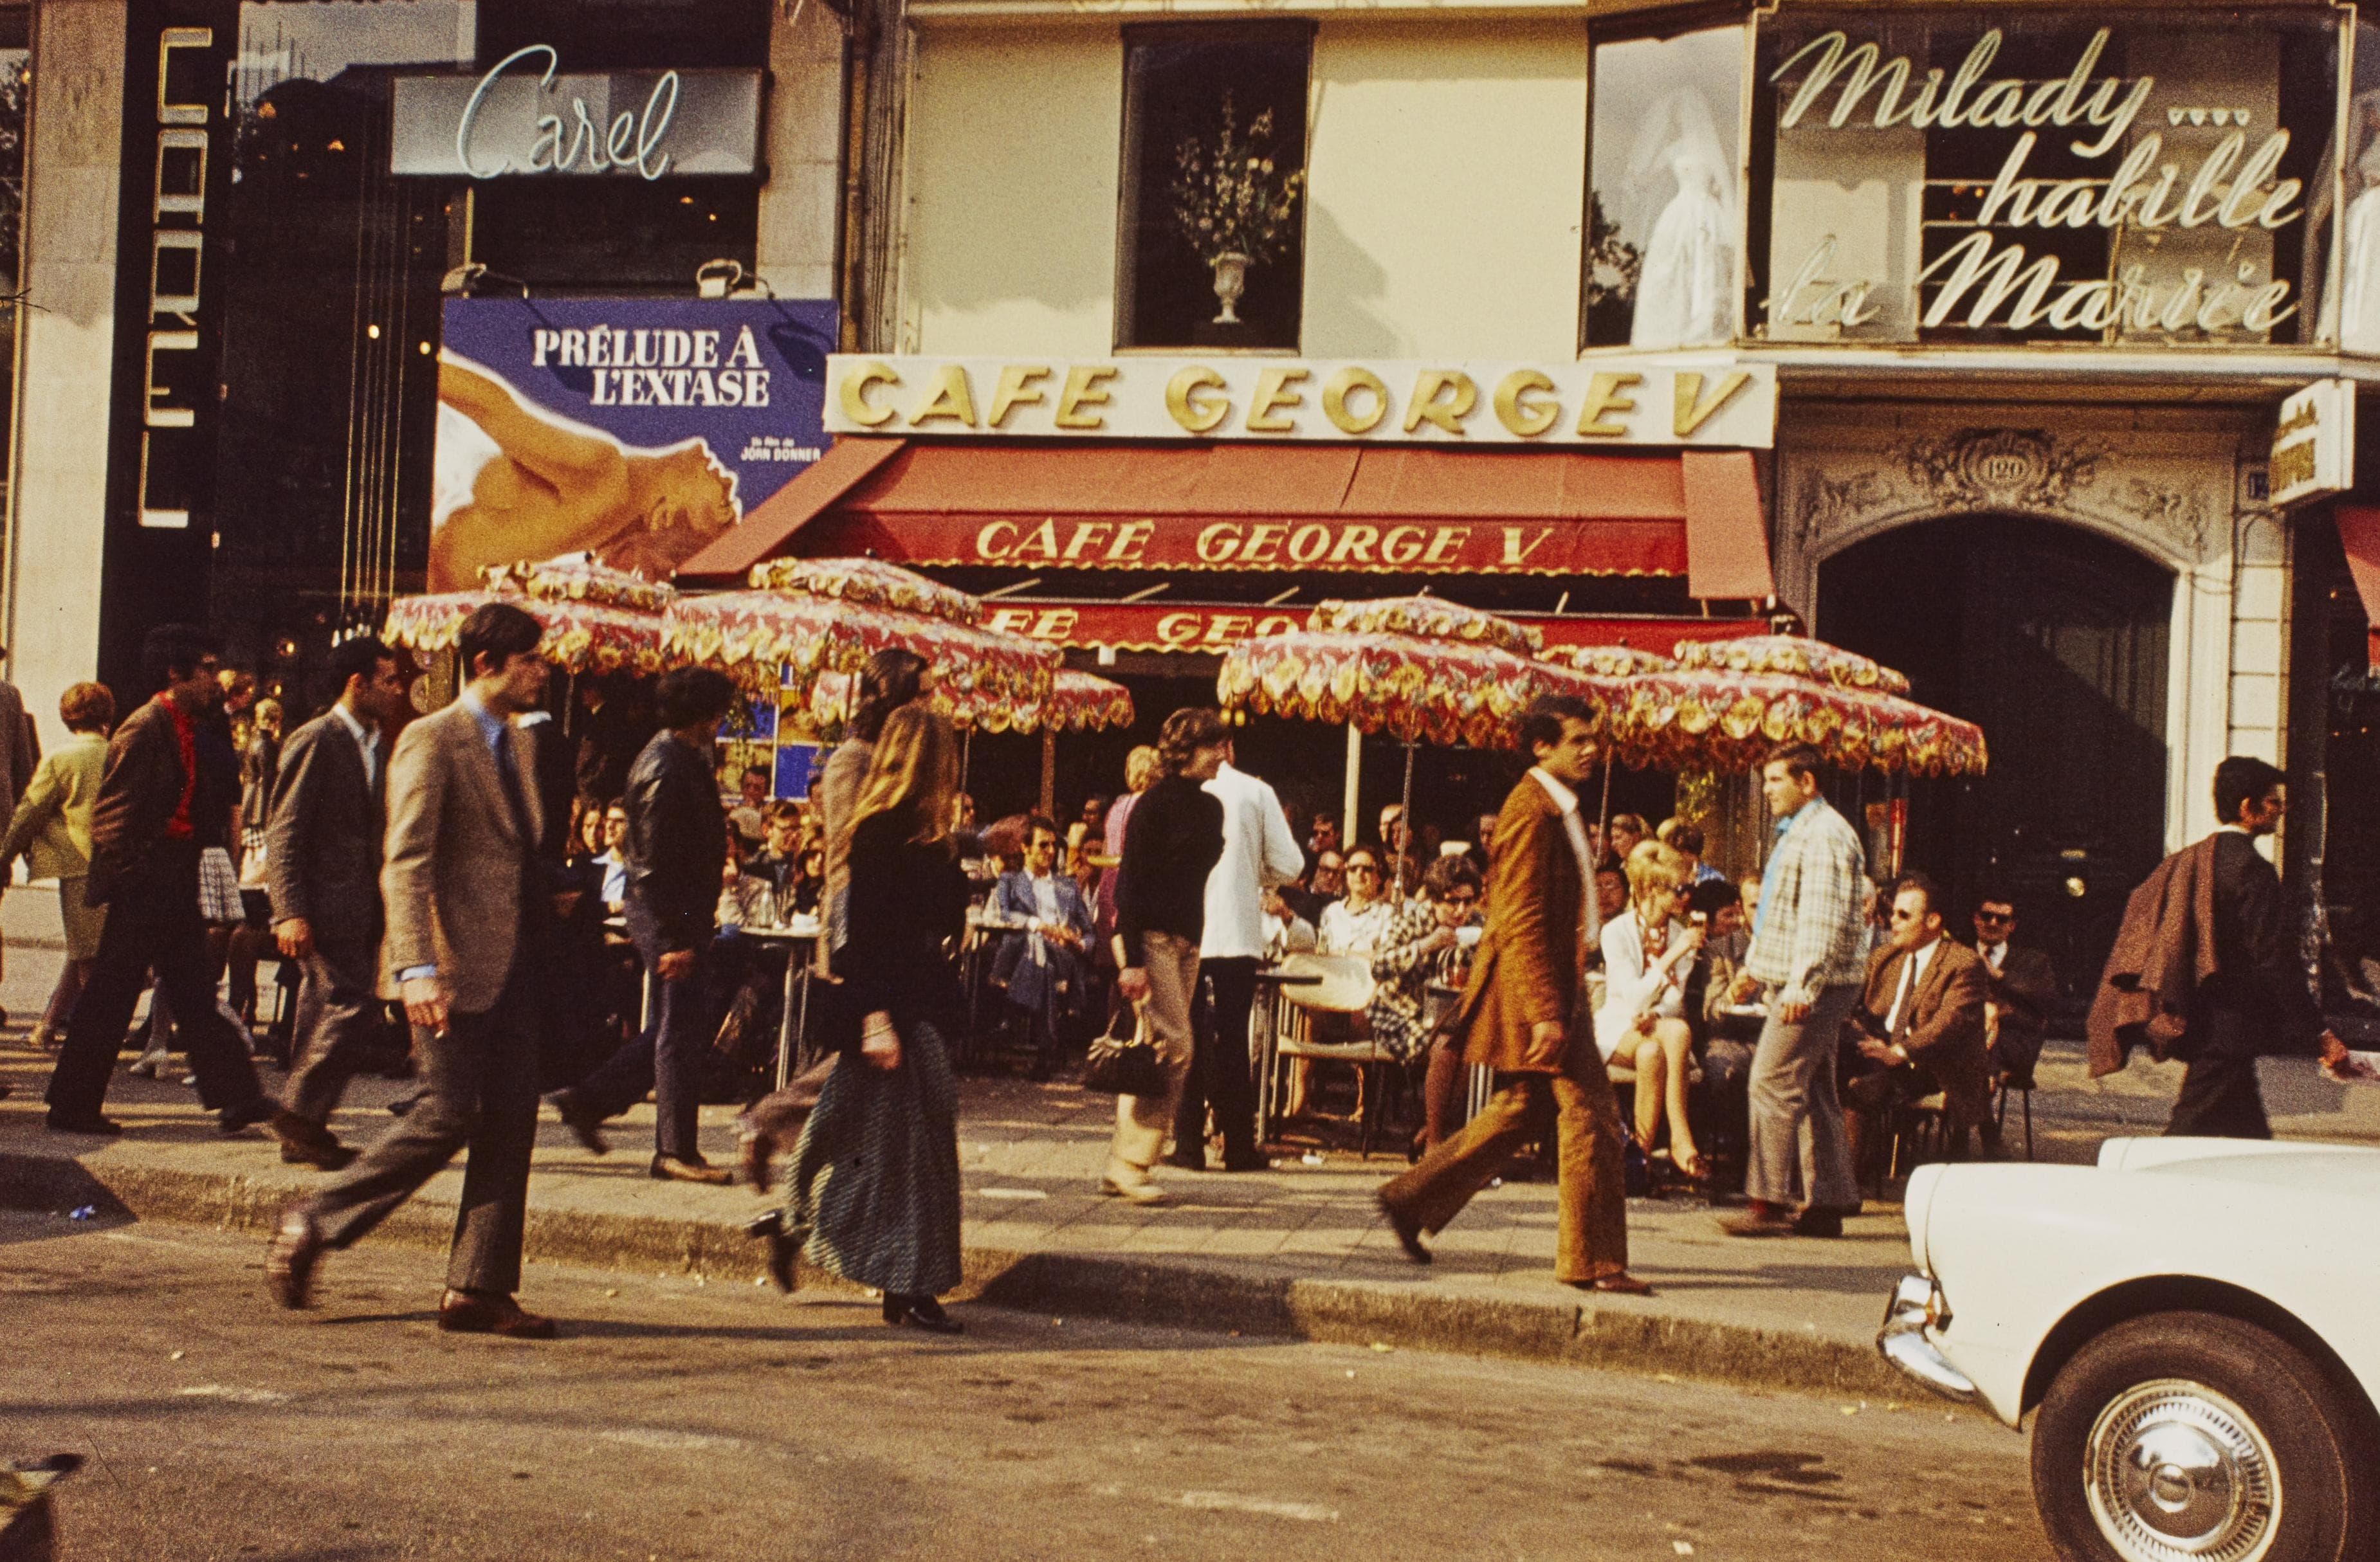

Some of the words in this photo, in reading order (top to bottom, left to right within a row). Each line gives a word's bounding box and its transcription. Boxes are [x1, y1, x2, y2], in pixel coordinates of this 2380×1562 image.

[457, 44, 677, 181] Carel
[1770, 28, 2155, 158] Milady
[1976, 130, 2303, 229] habille
[1759, 233, 1881, 326] la
[531, 323, 720, 368] PRÉLUDE
[589, 369, 771, 407] L'EXTASE
[839, 361, 1117, 429] CAFE
[1165, 365, 1644, 437] GEORGE
[1674, 371, 1752, 438] V
[1196, 522, 1471, 565] GEORGE
[1499, 526, 1554, 565] V
[1157, 612, 1300, 643] GEO
